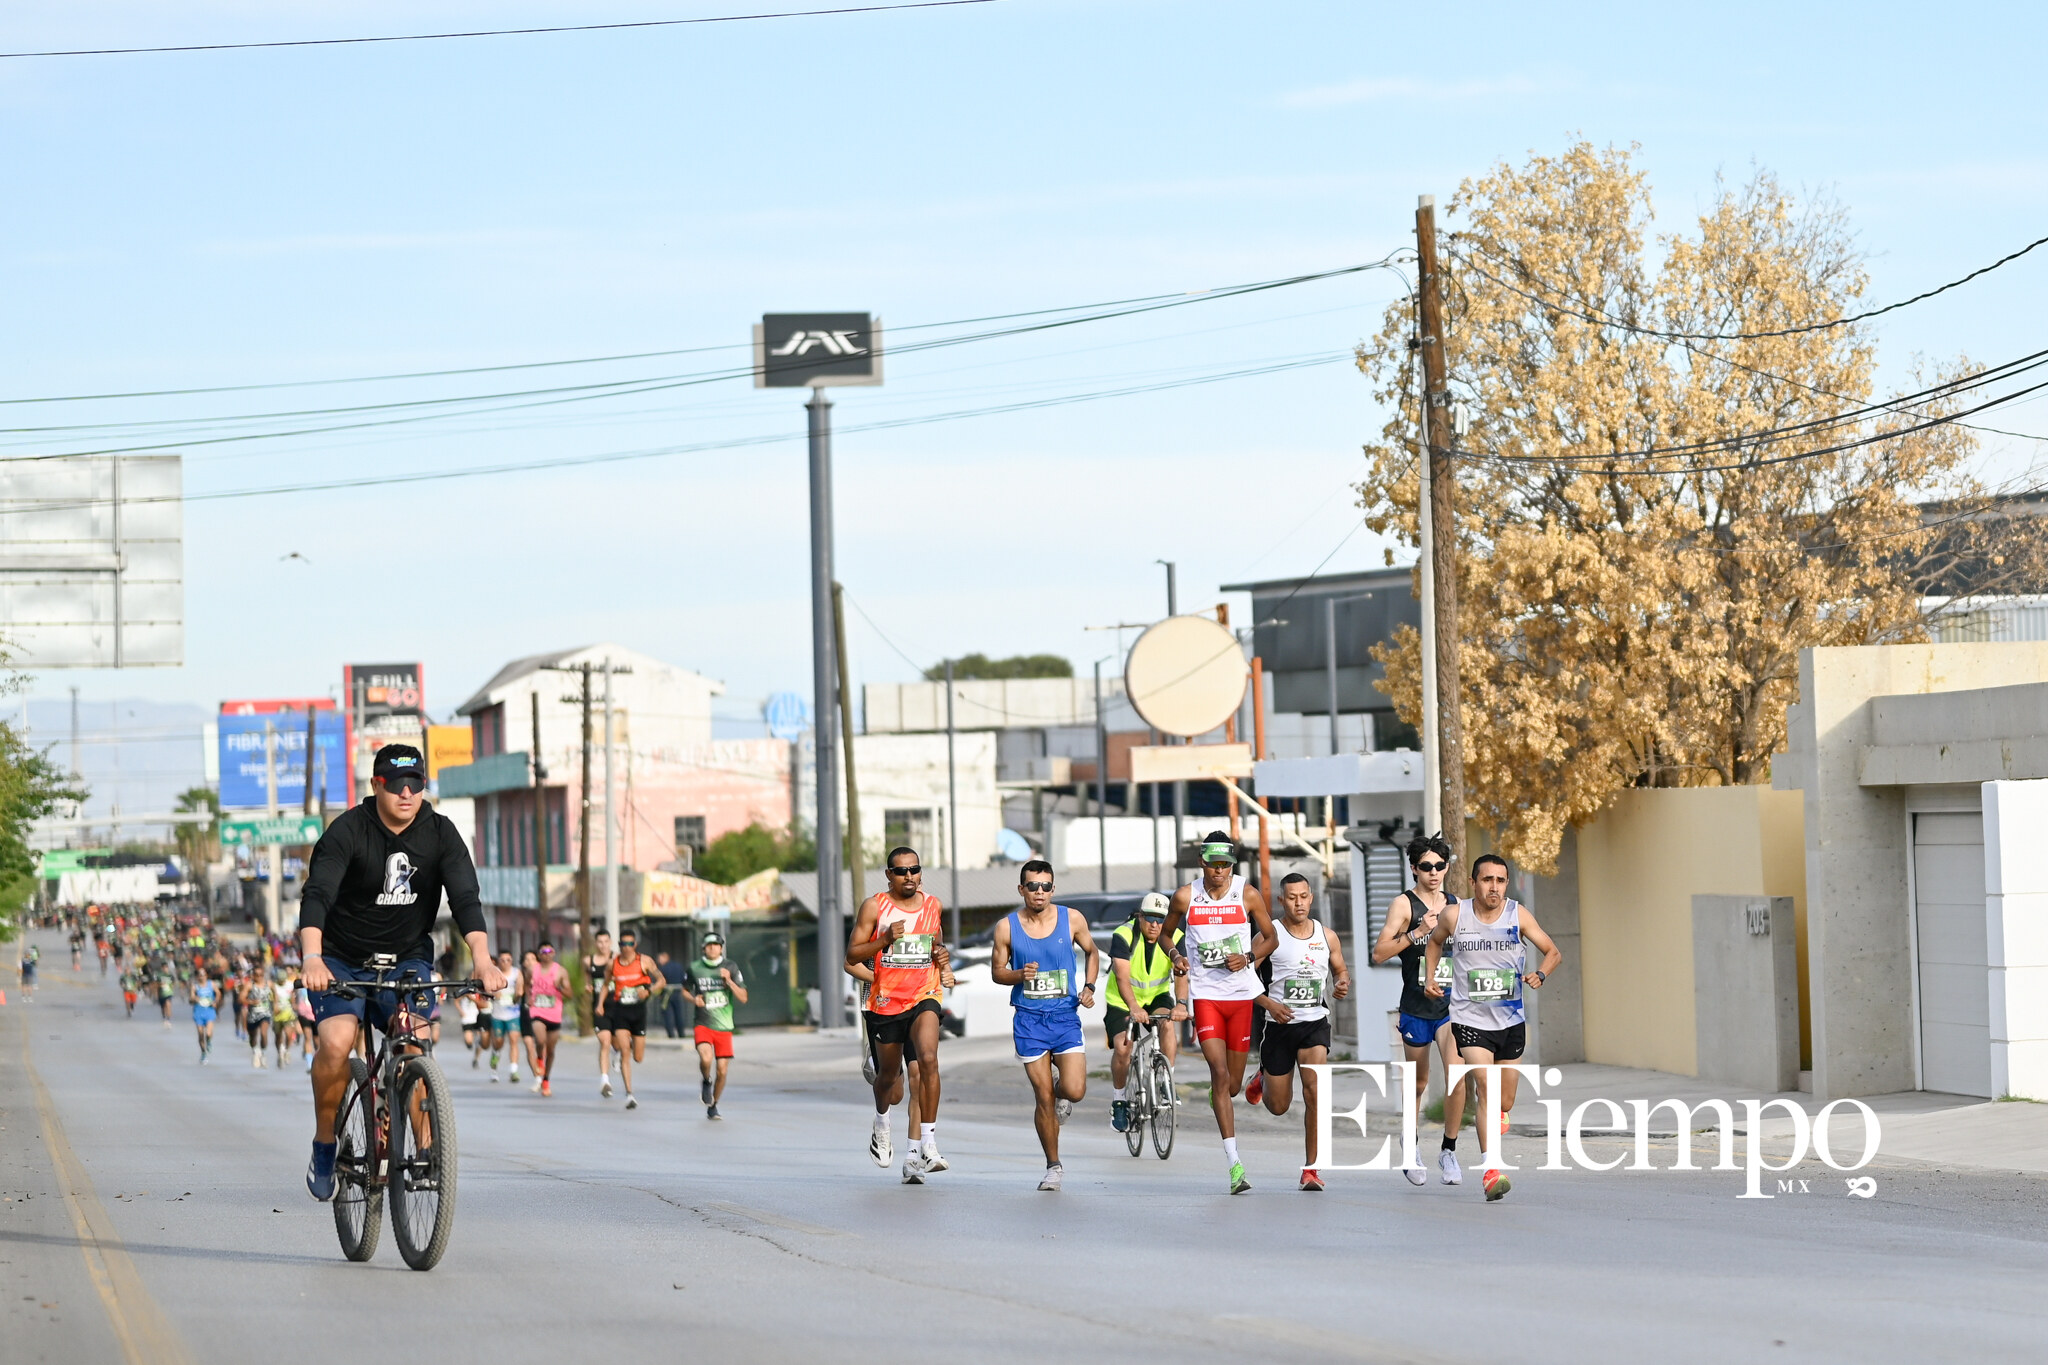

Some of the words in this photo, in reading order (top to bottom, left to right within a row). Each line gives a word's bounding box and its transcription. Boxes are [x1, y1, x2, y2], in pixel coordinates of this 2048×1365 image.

[375, 892, 418, 906] CHARRO
[1194, 907, 1218, 915] RODOLFO
[1208, 916, 1223, 924] CLUB
[899, 942, 925, 954] 146
[1457, 938, 1492, 952] ORDUÑA
[1434, 965, 1450, 977] 99
[1029, 977, 1056, 991] 185
[1474, 977, 1504, 992] 198
[1288, 987, 1315, 1000] 295
